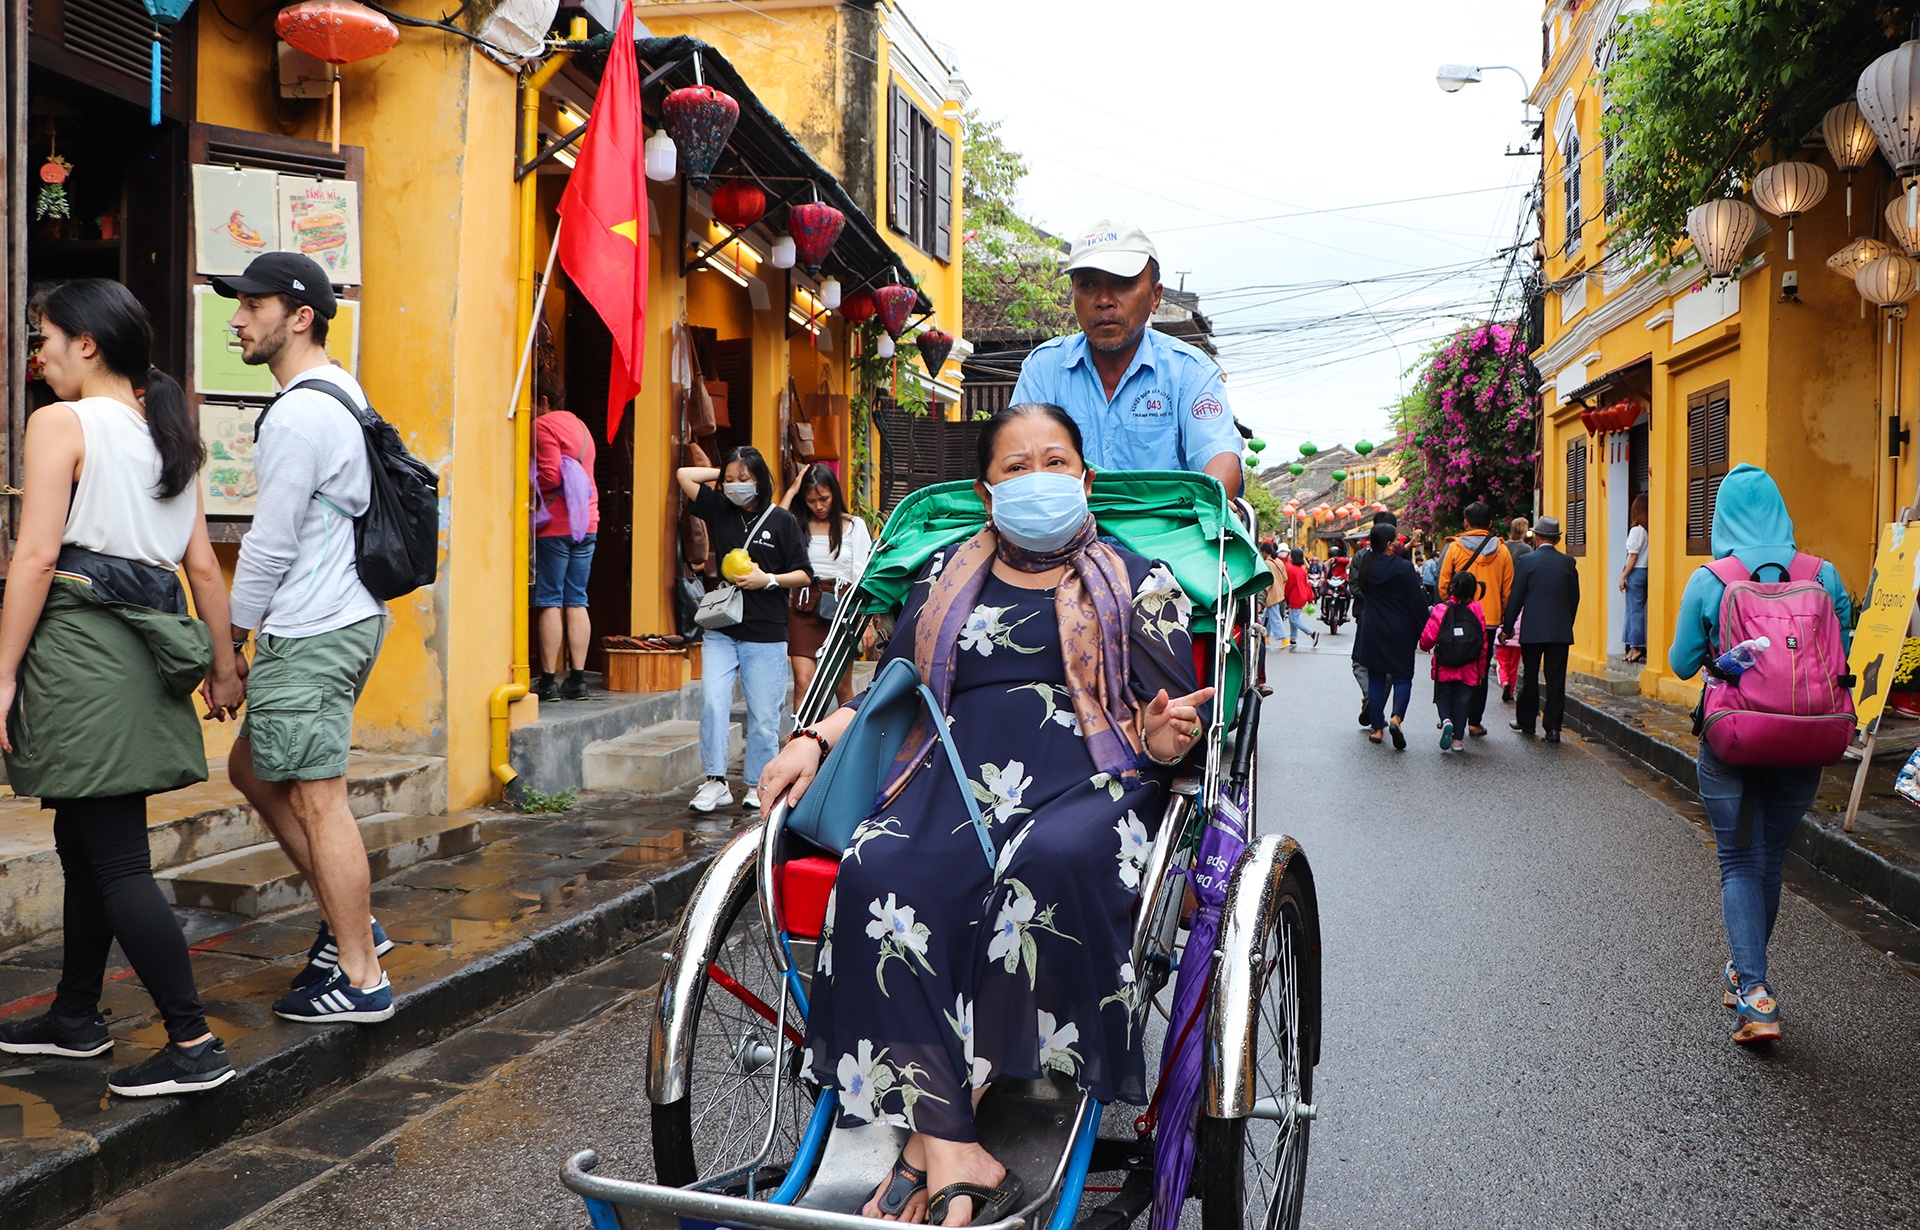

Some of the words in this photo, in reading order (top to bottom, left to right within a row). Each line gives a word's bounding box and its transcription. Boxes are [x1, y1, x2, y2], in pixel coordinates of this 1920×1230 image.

[1147, 400, 1161, 411] 043
[1874, 588, 1906, 611] Organic
[1206, 855, 1228, 873] Spa
